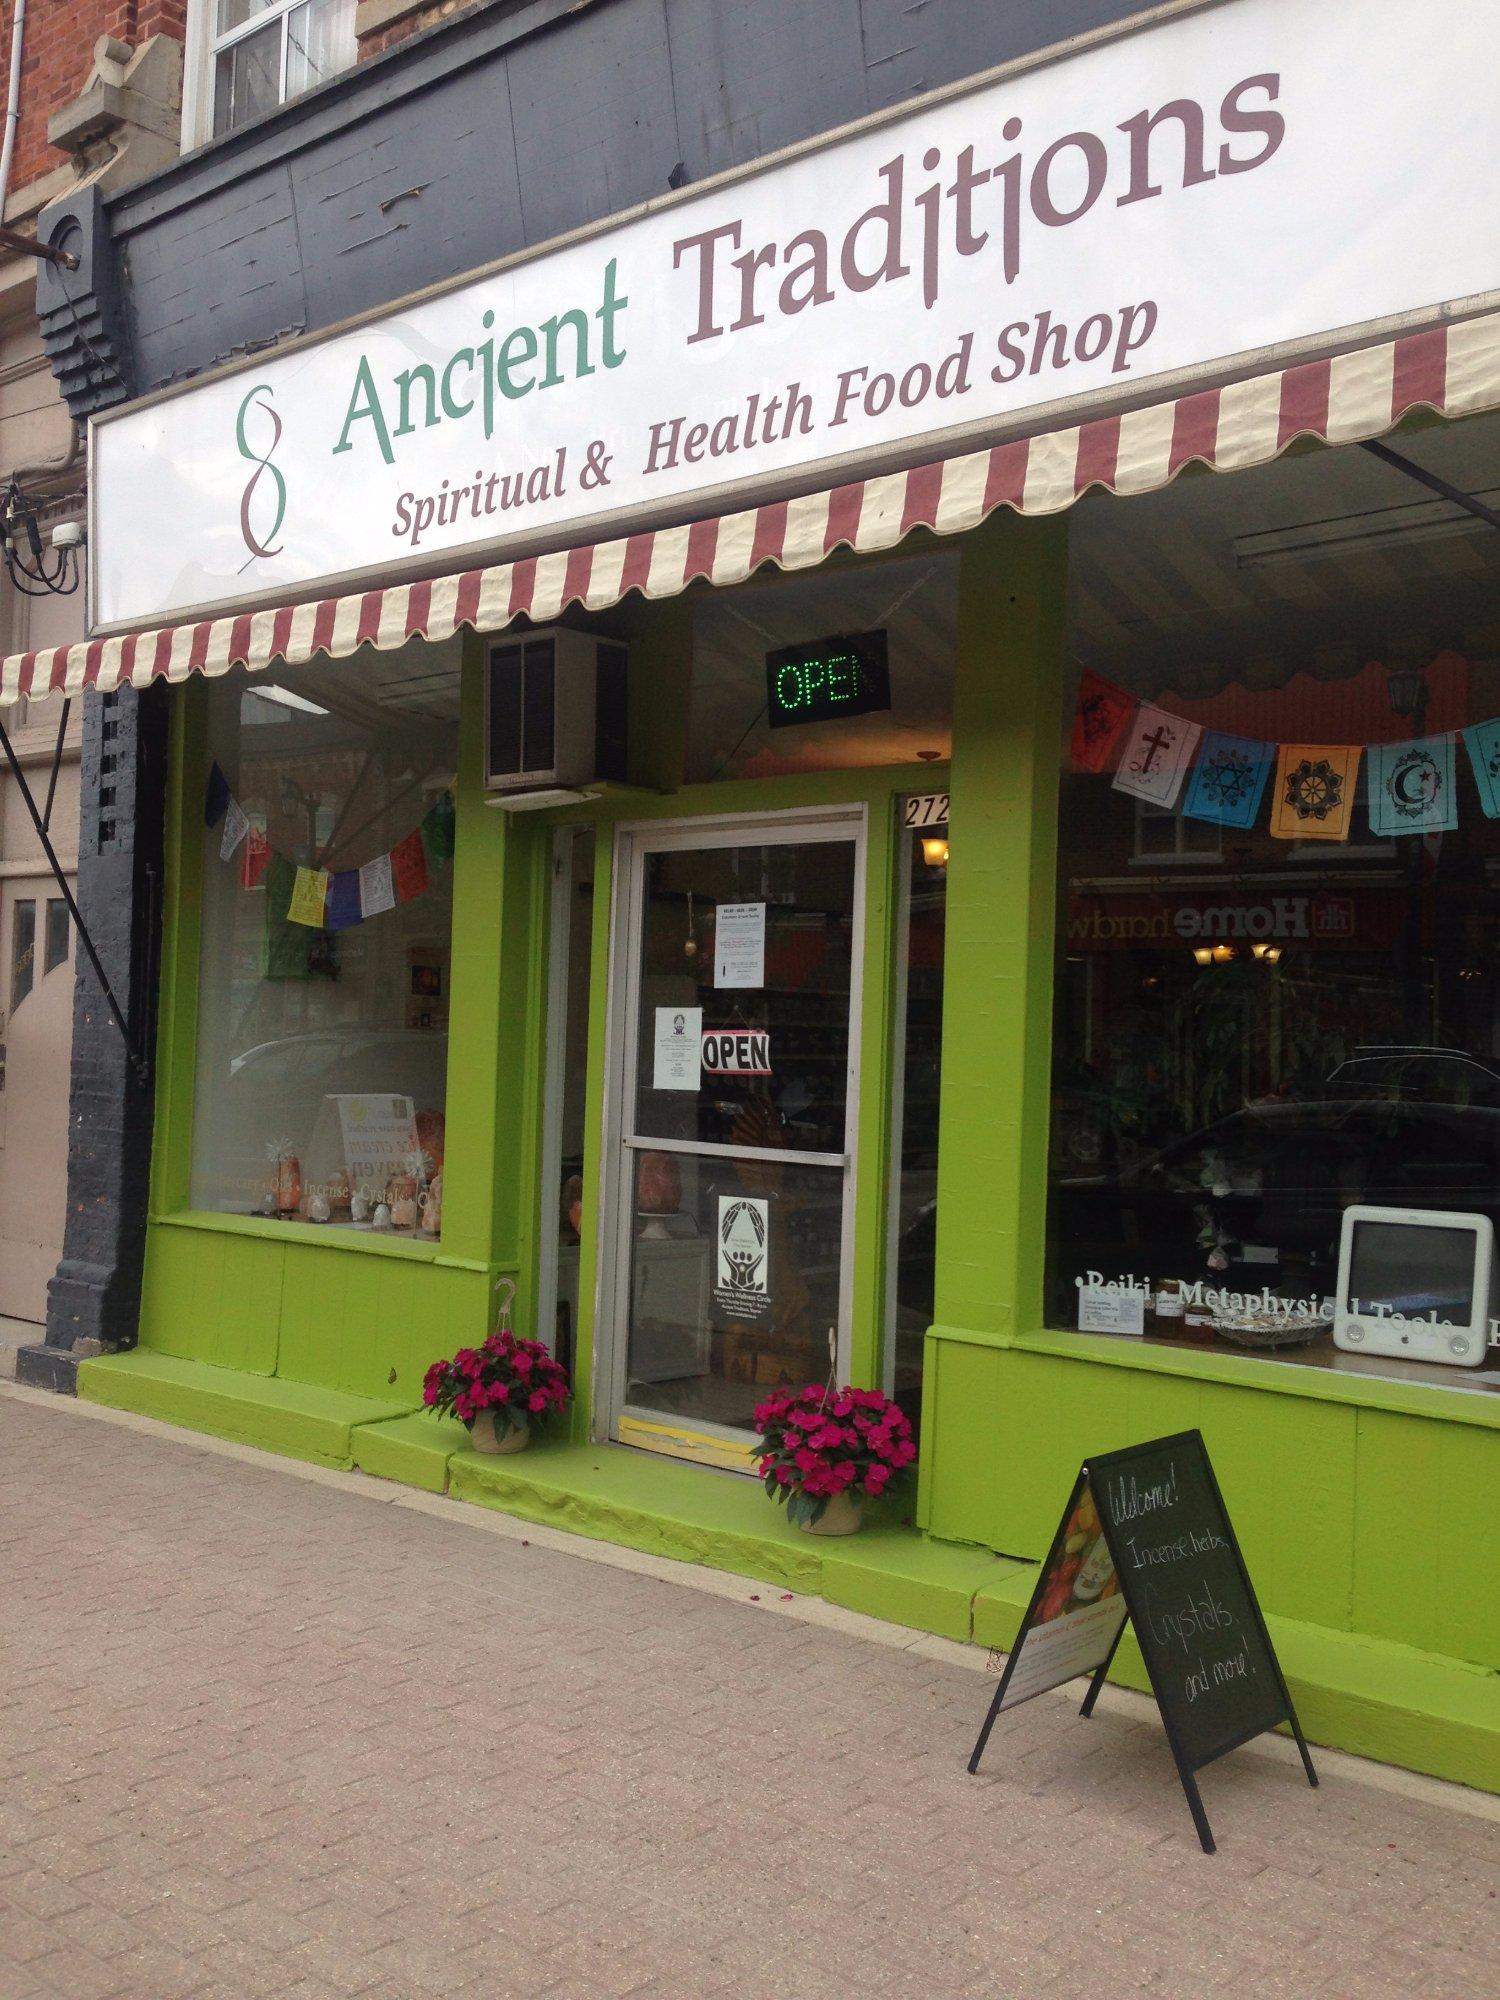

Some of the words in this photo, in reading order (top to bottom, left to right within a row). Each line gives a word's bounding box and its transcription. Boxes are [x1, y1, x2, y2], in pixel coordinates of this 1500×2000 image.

[392, 447, 567, 546] Spiritual
[579, 440, 614, 490] &
[643, 382, 815, 475] Health
[828, 334, 975, 427] Food
[990, 300, 1159, 384] Shop
[905, 795, 950, 826] 272
[703, 1035, 768, 1069] OPEN
[304, 1179, 349, 1199] Incense
[1086, 1270, 1151, 1301] Reiki
[1178, 1280, 1360, 1326] Metaphysicl
[1108, 1461, 1179, 1527] Welcome!
[1185, 1656, 1210, 1703] and
[1213, 1632, 1257, 1686] more!
